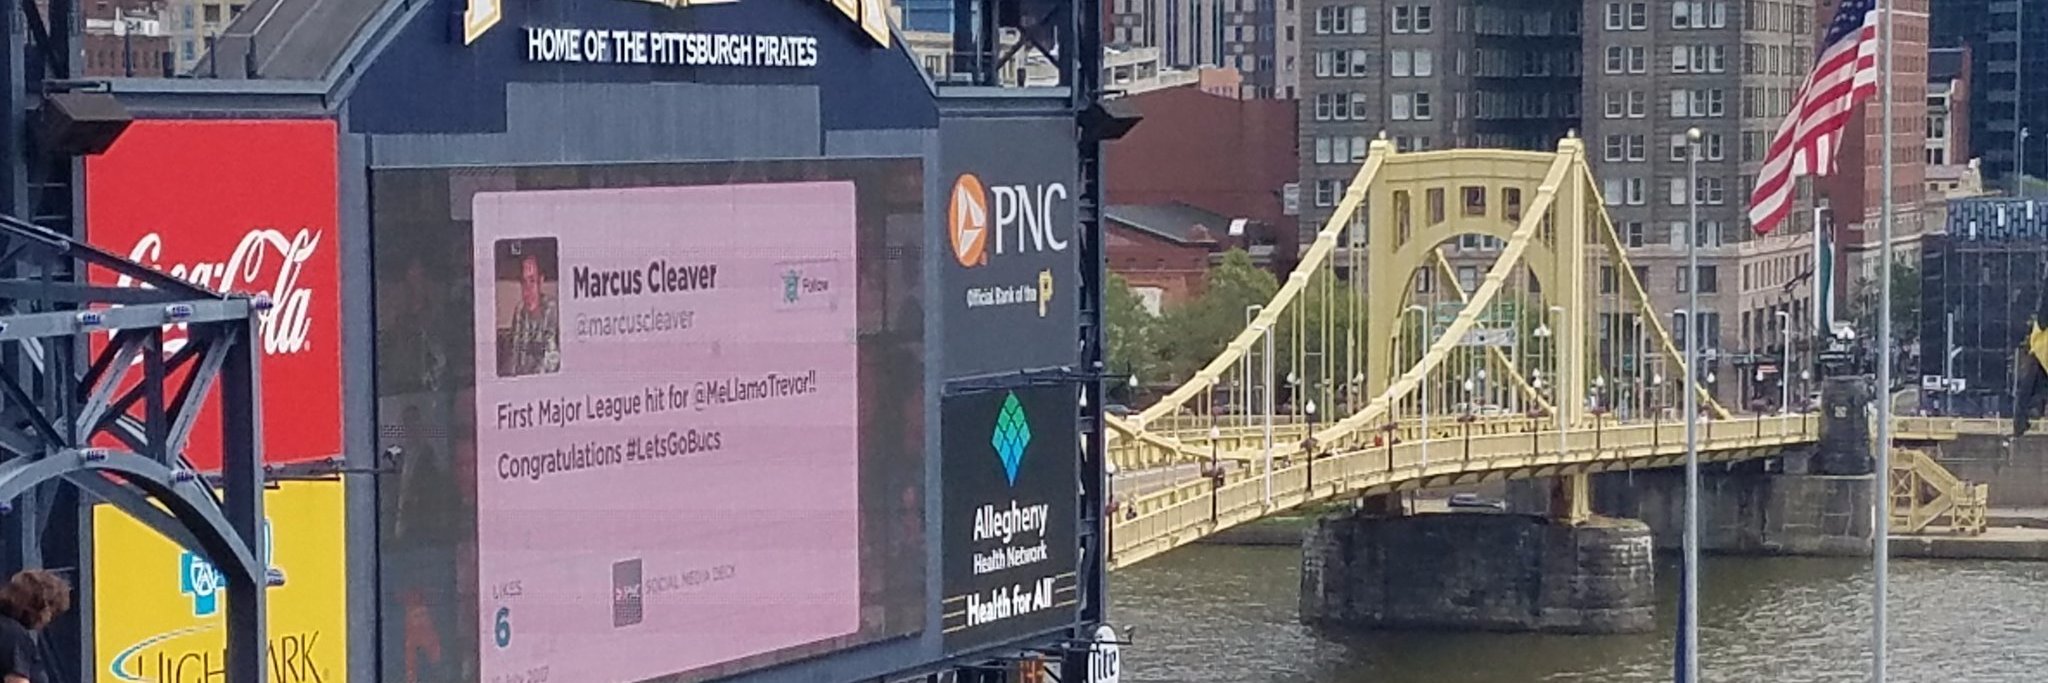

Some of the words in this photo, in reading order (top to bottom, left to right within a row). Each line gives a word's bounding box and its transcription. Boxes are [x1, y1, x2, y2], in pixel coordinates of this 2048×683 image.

[529, 27, 582, 61] HOME
[584, 29, 609, 61] OF
[612, 30, 648, 63] THE
[650, 32, 752, 65] PITTSBURGH
[755, 35, 817, 67] PIRATES
[991, 182, 1068, 254] PNC
[108, 228, 322, 365] Cca-Cla
[573, 265, 642, 299] Marcus
[647, 260, 717, 293] Cleaver
[966, 287, 995, 309] Official
[996, 285, 1014, 305] Bank
[1015, 285, 1023, 303] of
[1024, 284, 1037, 302] the
[577, 306, 694, 343] @marcuscleaver
[497, 402, 534, 429] First
[539, 396, 582, 427] Major
[586, 393, 641, 421] League
[645, 386, 665, 413] hit
[668, 384, 689, 410] for
[694, 369, 817, 411] @MeLlamoTrevor!!
[498, 441, 622, 480] Congratulations
[626, 429, 721, 461] #LetsGoBucs
[974, 500, 1048, 543] Allegheny
[973, 548, 1005, 574] Health
[1006, 540, 1048, 567] Network
[967, 587, 1011, 626] Health
[1012, 584, 1031, 616] for
[1032, 577, 1053, 611] All
[494, 606, 511, 648] 6
[137, 630, 321, 683] HIGHARK
